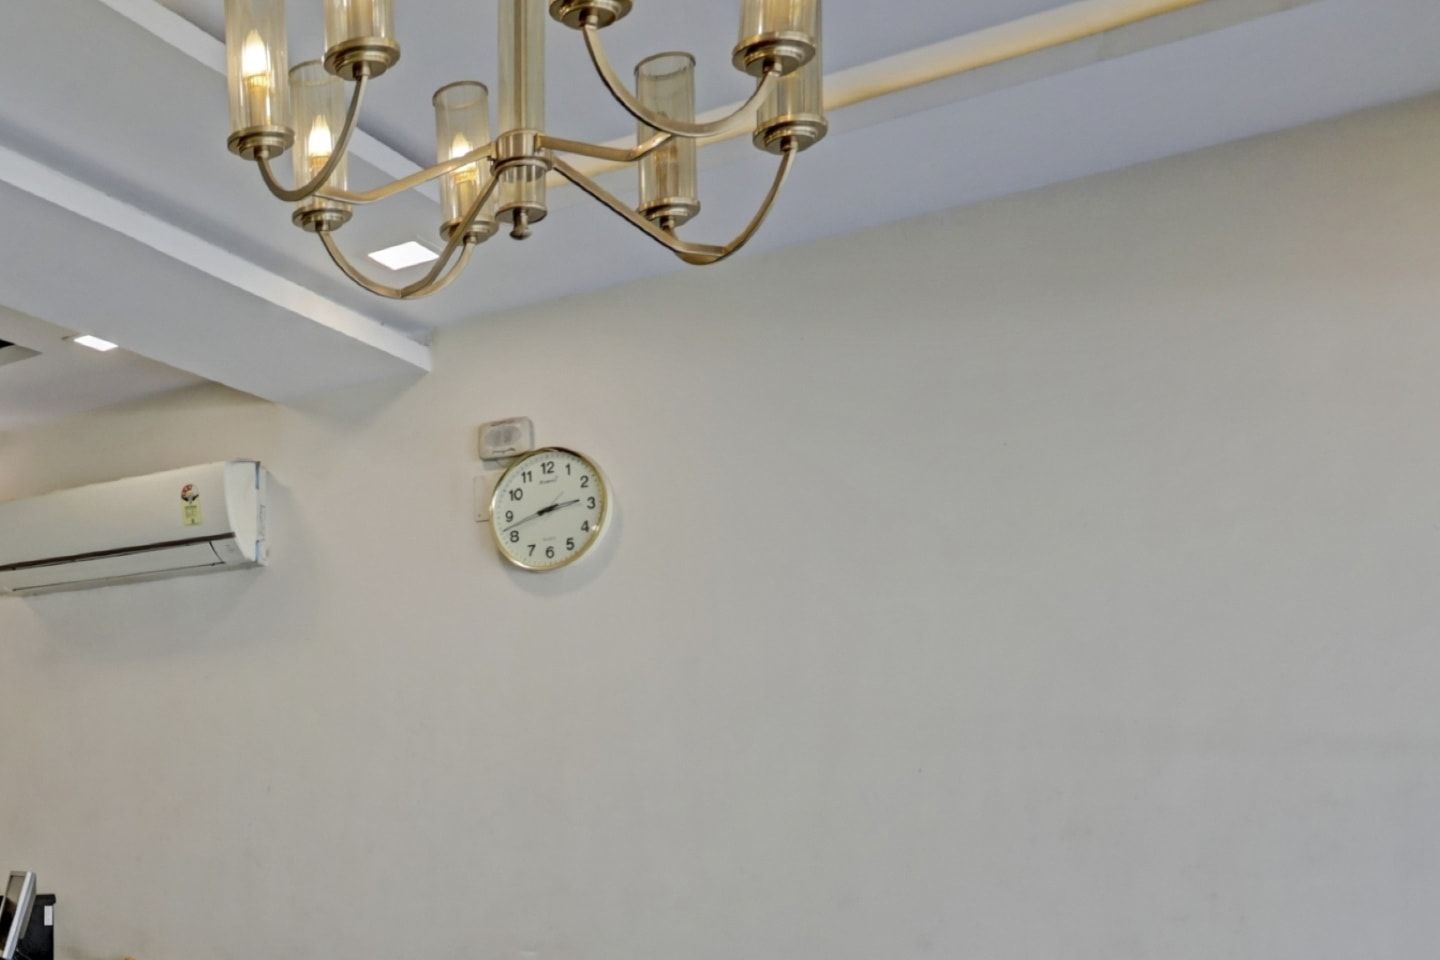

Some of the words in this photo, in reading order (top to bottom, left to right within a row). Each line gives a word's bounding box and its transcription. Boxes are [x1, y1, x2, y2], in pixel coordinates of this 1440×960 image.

[540, 461, 555, 475] 12
[565, 464, 571, 476] 1
[521, 471, 533, 484] 11
[579, 475, 589, 488] 2
[509, 488, 523, 501] 10
[587, 496, 596, 509] 3
[505, 510, 514, 523] 9
[580, 520, 590, 532] 4
[510, 530, 520, 543] 8
[528, 544, 536, 557] 7
[566, 537, 575, 551] 5
[545, 546, 555, 559] 6
